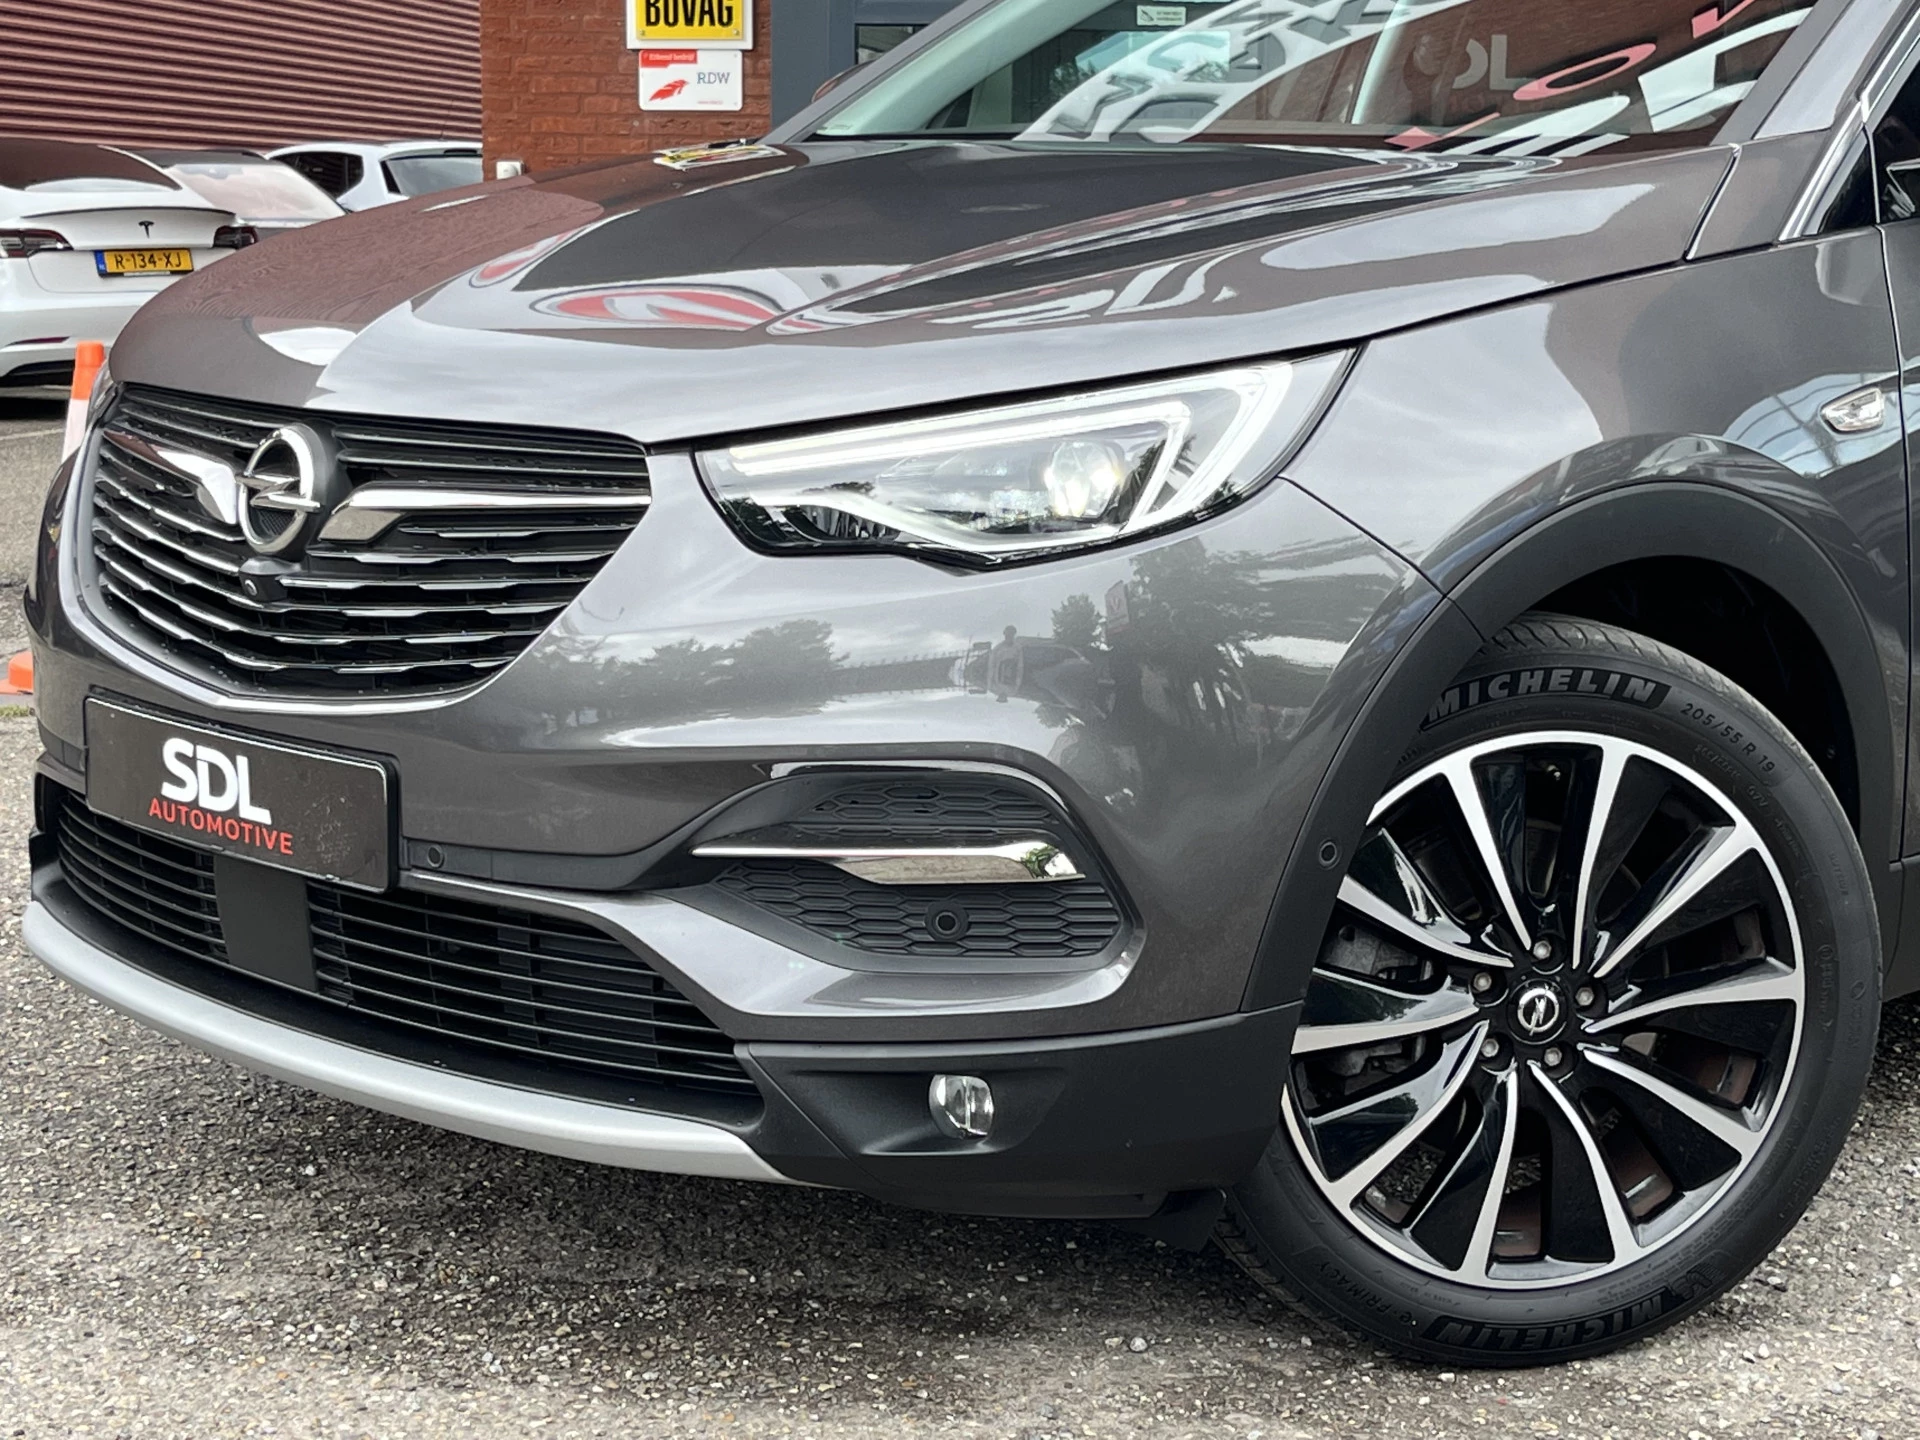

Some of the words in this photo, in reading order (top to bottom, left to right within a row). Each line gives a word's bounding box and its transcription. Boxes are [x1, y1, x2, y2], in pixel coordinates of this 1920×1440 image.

[645, 0, 733, 27] BOVAG
[696, 71, 731, 85] RDW
[114, 252, 182, 270] R-134-XJ
[1428, 668, 1656, 722] MICHELIN
[1680, 703, 1744, 744] 205/55
[1742, 742, 1757, 757] R
[1757, 755, 1776, 773] 19
[160, 737, 273, 826] SDL
[148, 797, 294, 856] AUTOMOTIVE
[1435, 1292, 1665, 1350] MICHELIN
